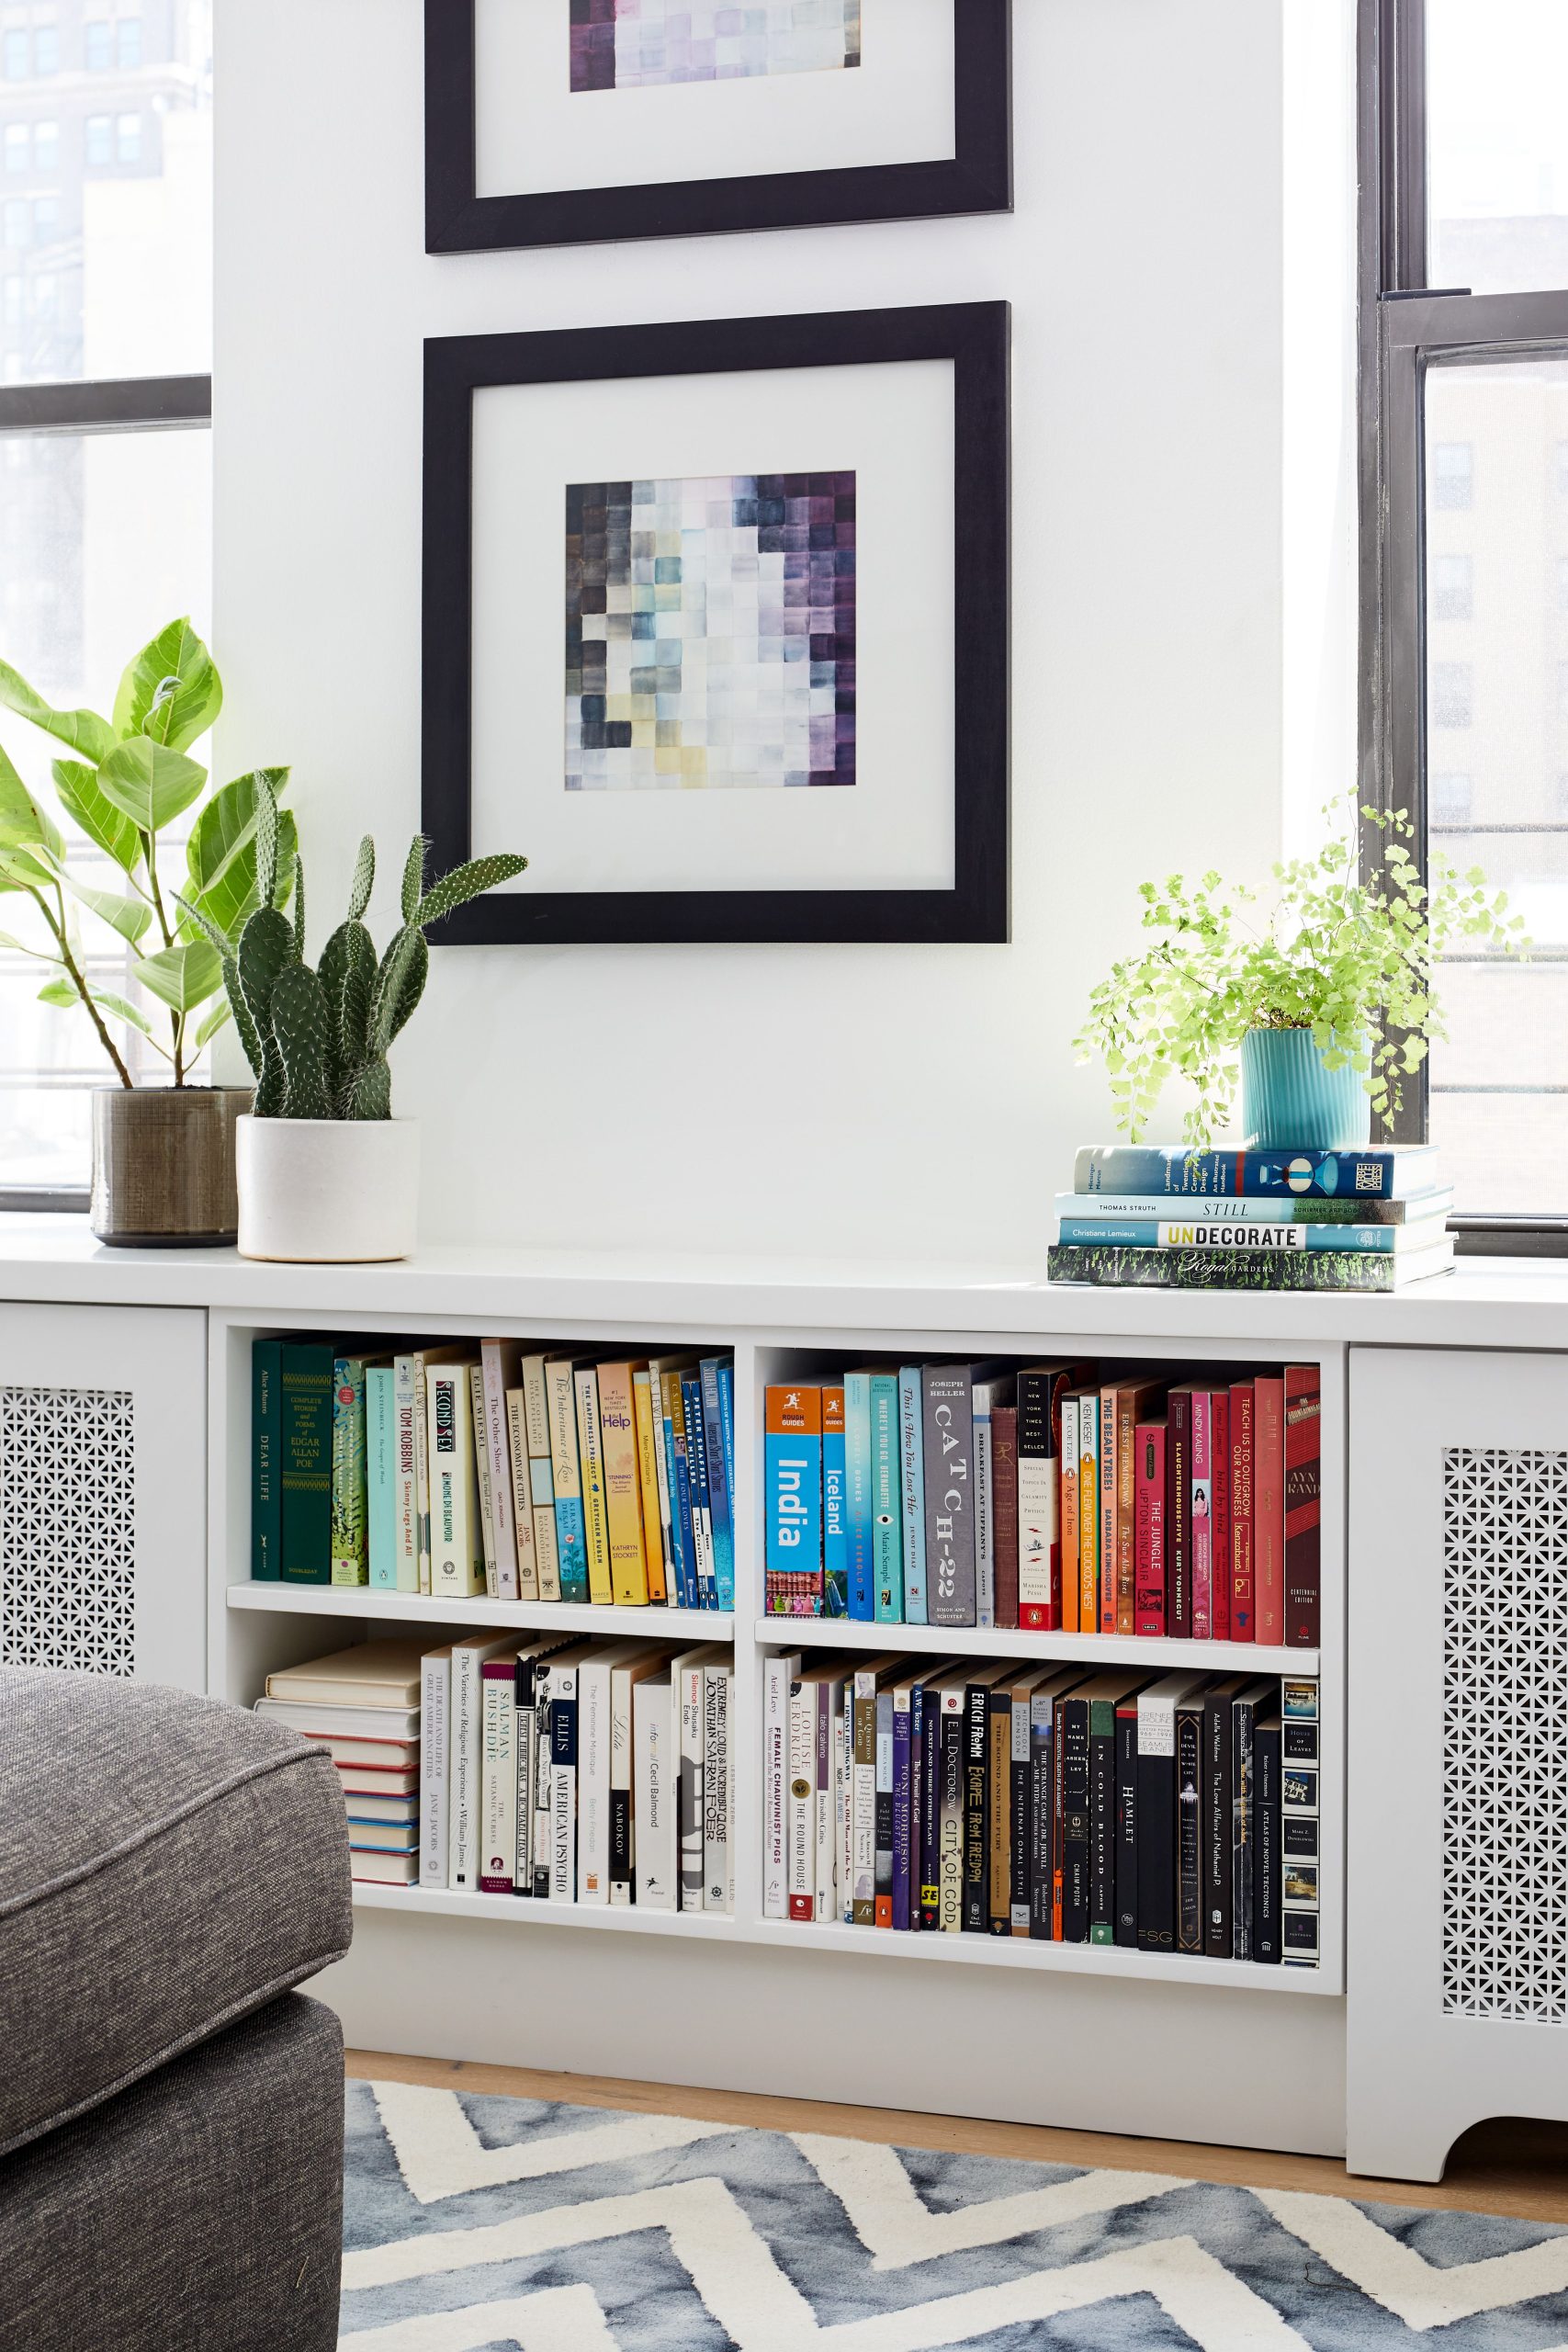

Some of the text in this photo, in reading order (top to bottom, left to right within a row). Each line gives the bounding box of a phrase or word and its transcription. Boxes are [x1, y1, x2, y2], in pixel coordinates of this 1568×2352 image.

[1213, 1184, 1218, 1193] An
[1203, 1204, 1248, 1216] STILL
[1168, 1227, 1297, 1247] UNDECORATE
[1178, 1250, 1249, 1283] Royal
[436, 1382, 452, 1452] SECOND SEX
[904, 1387, 913, 1409] This
[1194, 1404, 1202, 1430] MINDY
[291, 1437, 319, 1445] EDGAR
[400, 1408, 413, 1473] TOM ROBBINS
[556, 1370, 572, 1484] The Inheritance of Loss
[603, 1413, 630, 1430] Help
[684, 1399, 696, 1484] ARTHUR MILLER
[904, 1424, 914, 1448] How
[1083, 1404, 1092, 1444] KEN KESEY
[1242, 1433, 1249, 1446] US
[513, 1424, 523, 1469] ECONOMY
[642, 1435, 652, 1485] Mere Christianity
[694, 1397, 705, 1487] PETER SHAFFER
[905, 1452, 914, 1467] You
[1242, 1449, 1249, 1462] TO
[261, 1436, 269, 1500] DEAR LIFE
[297, 1459, 312, 1467] POE
[516, 1470, 523, 1482] OF
[906, 1471, 915, 1492] Lose
[1234, 1446, 1242, 1517] OUR MADNESS
[403, 1481, 412, 1506] Skinny
[517, 1483, 525, 1510] CITIES
[778, 1460, 807, 1546] India
[827, 1470, 842, 1534] Iceland
[907, 1496, 917, 1516] Her
[935, 1405, 967, 1598] CATCH-22
[402, 1510, 412, 1526] Legs
[1139, 1488, 1148, 1580] UPTON SINCLAIR
[1151, 1501, 1160, 1569] THE JUNGLE
[1084, 1472, 1092, 1610] ONE FLEW OVER THE CUCKOO'S NEST
[691, 1705, 699, 1738] Shusaku
[717, 1677, 727, 1727] EXTREMELY
[914, 1711, 922, 1731] Tozer
[557, 1715, 569, 1750] ELLIS
[717, 1731, 727, 1756] LOUD
[971, 1693, 984, 1758] ERICH FROMM
[457, 1655, 469, 1867] The Varieties of Religious Experience William James
[706, 1678, 716, 1841] JONATHAN SAFRAN FOER
[947, 1722, 958, 1811] E. L. DOCTOROW
[1098, 1746, 1104, 1760] IN
[650, 1764, 659, 1827] Cecil Balmond
[717, 1766, 727, 1813] INCREDIBLY
[556, 1772, 568, 1893] AMERICAN PSYCHO
[615, 1804, 624, 1854] NABOKOV
[716, 1814, 727, 1842] CLOSE
[967, 1767, 984, 1882] ESCAPE FROM FREEDOM
[1122, 1786, 1134, 1843] HAMLET
[1213, 1807, 1222, 1831] Affairs
[796, 1804, 805, 1890] THE ROUND HOUSE
[1213, 1843, 1222, 1878] Nathaniel
[1263, 1838, 1269, 1847] OF
[944, 1820, 957, 1923] CITY OF GOD
